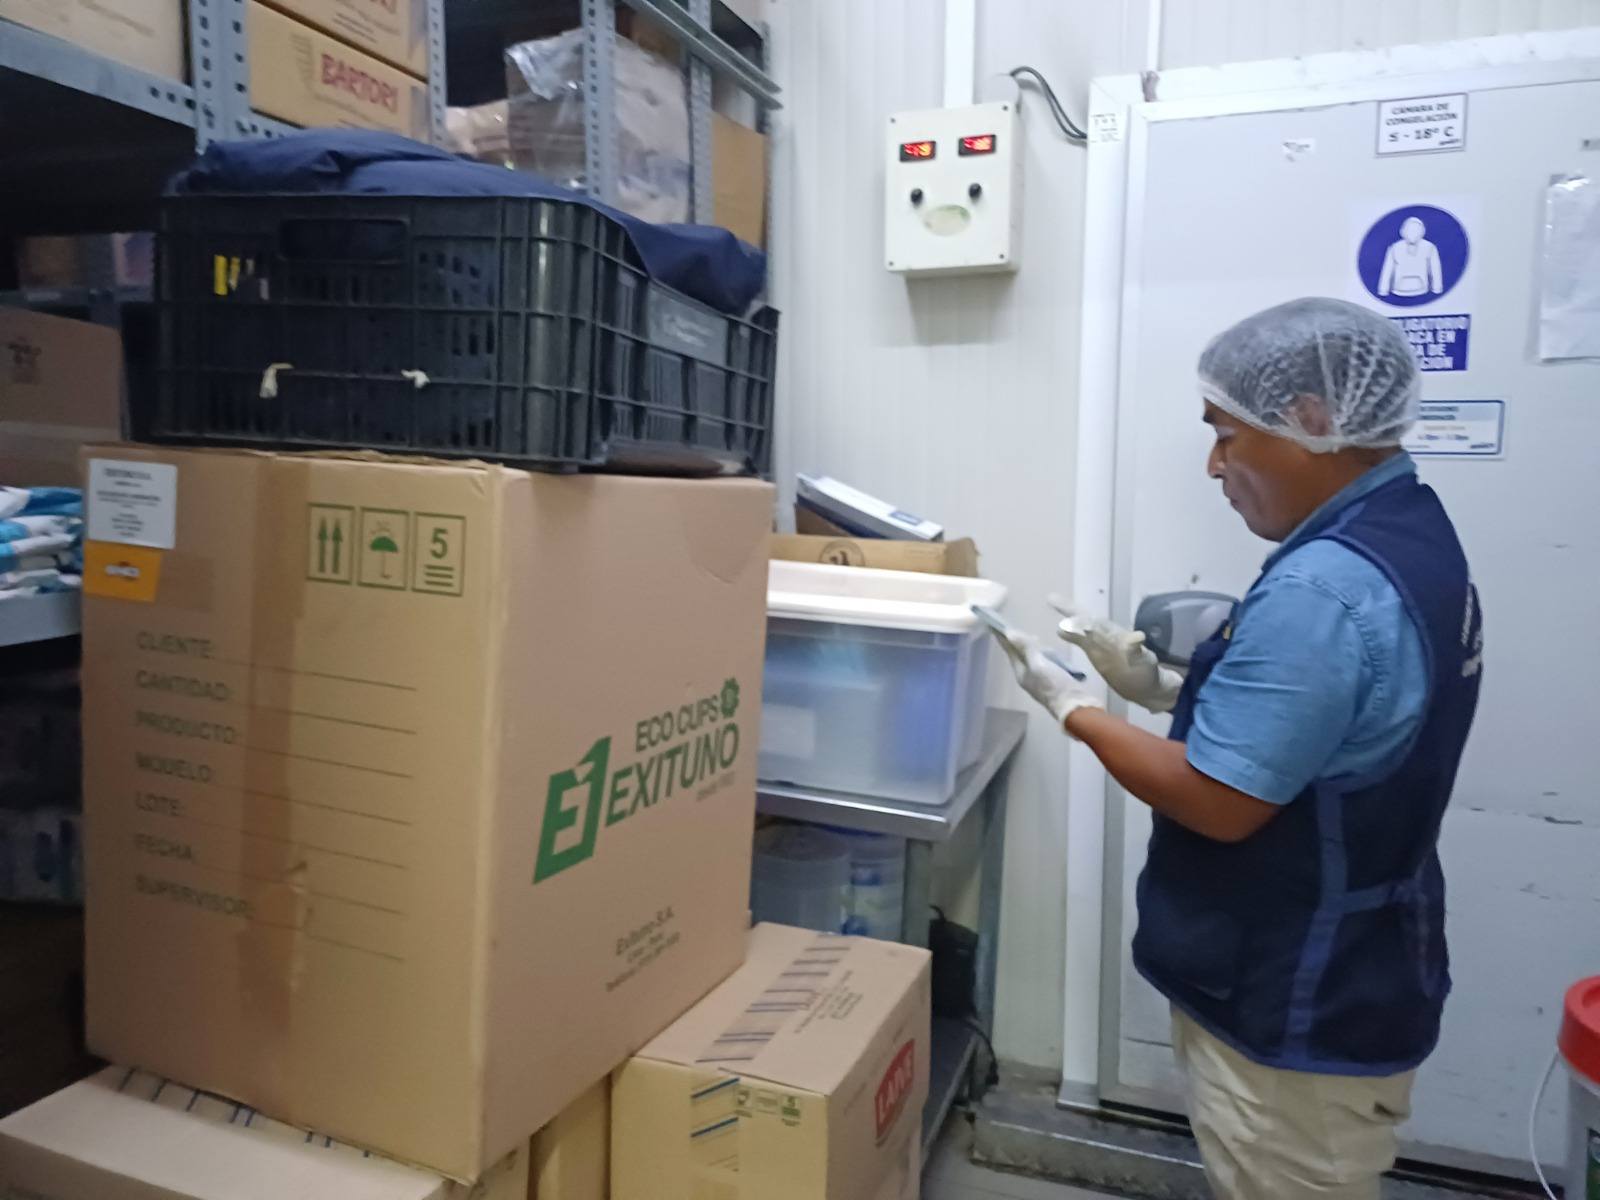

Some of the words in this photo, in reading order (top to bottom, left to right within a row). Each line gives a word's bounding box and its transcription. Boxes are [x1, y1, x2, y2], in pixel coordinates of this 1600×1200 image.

[429, 527, 449, 560] 5
[635, 711, 674, 752] ECO
[677, 695, 719, 735] CUPS
[605, 722, 740, 827] EXITUNO
